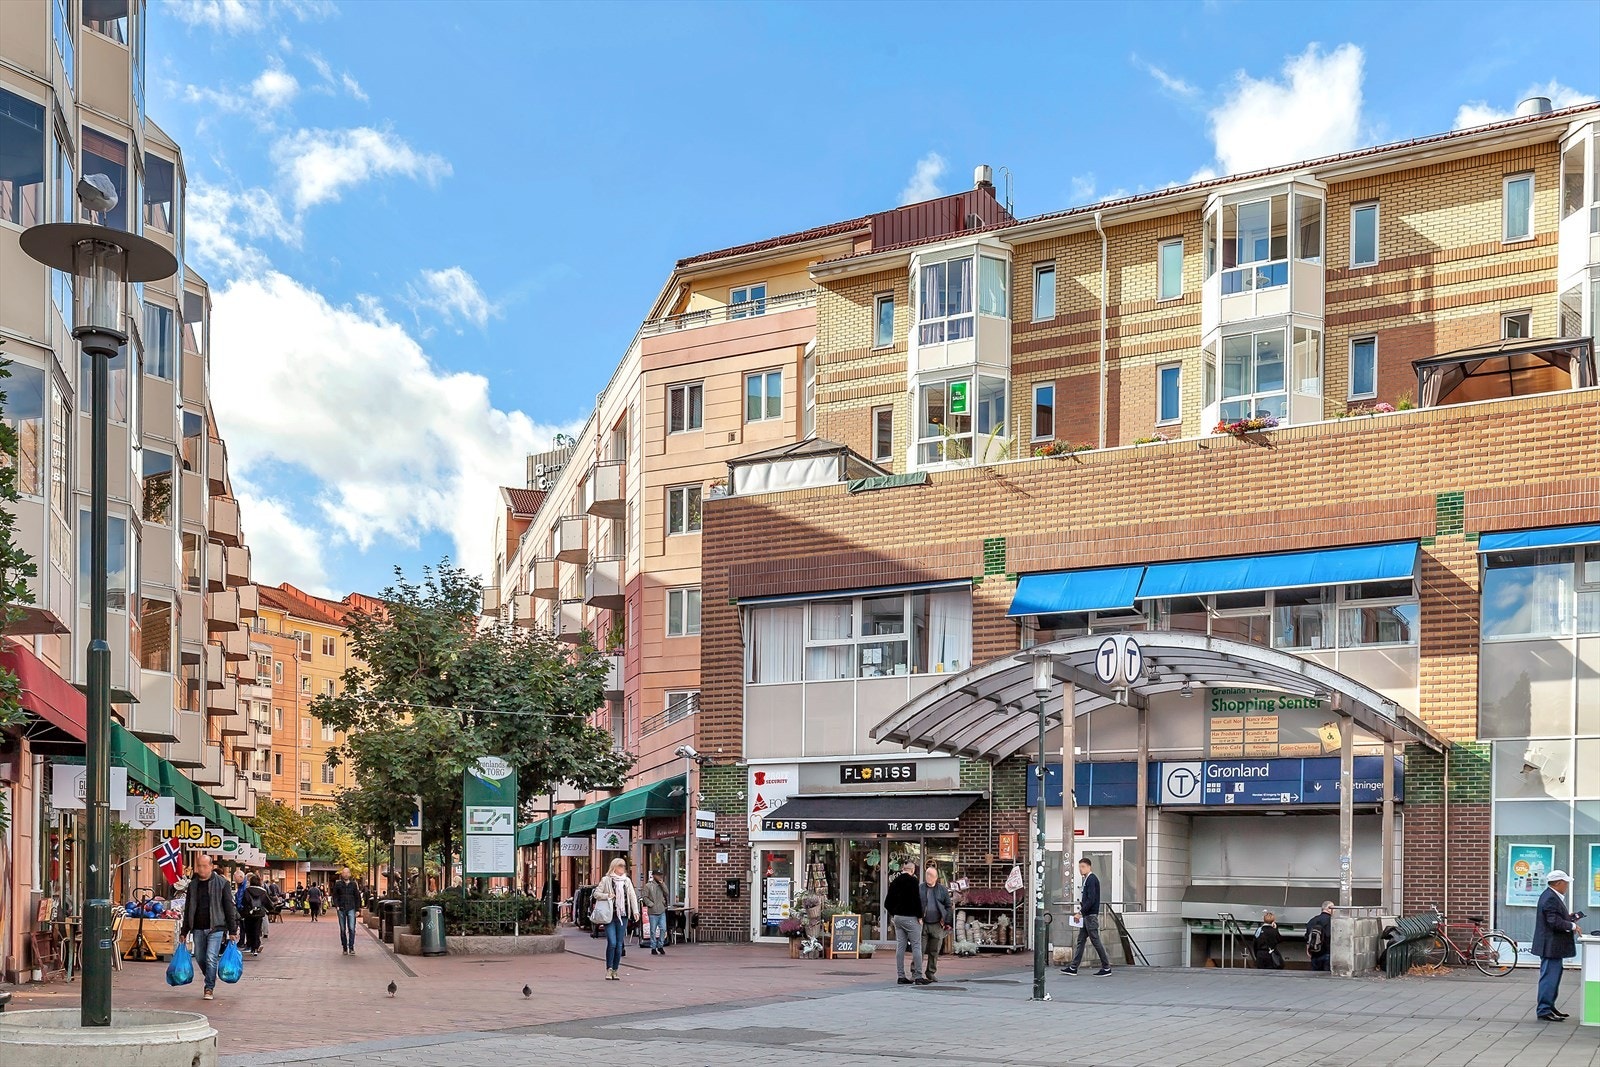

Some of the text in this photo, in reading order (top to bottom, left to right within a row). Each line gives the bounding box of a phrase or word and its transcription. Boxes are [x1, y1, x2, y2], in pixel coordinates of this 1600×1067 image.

[1102, 648, 1114, 676] T
[1127, 648, 1137, 676] T
[1211, 695, 1324, 713] Shopping Senter
[487, 768, 505, 776] TORG
[844, 766, 911, 779] FLORISS
[1174, 774, 1189, 794] T
[1207, 763, 1269, 778] Grønland
[139, 807, 155, 815] GLADE
[765, 821, 808, 830] FLORISS
[901, 822, 912, 831] 22
[914, 822, 923, 831] 17
[924, 822, 936, 831] 58
[938, 822, 950, 831] 50
